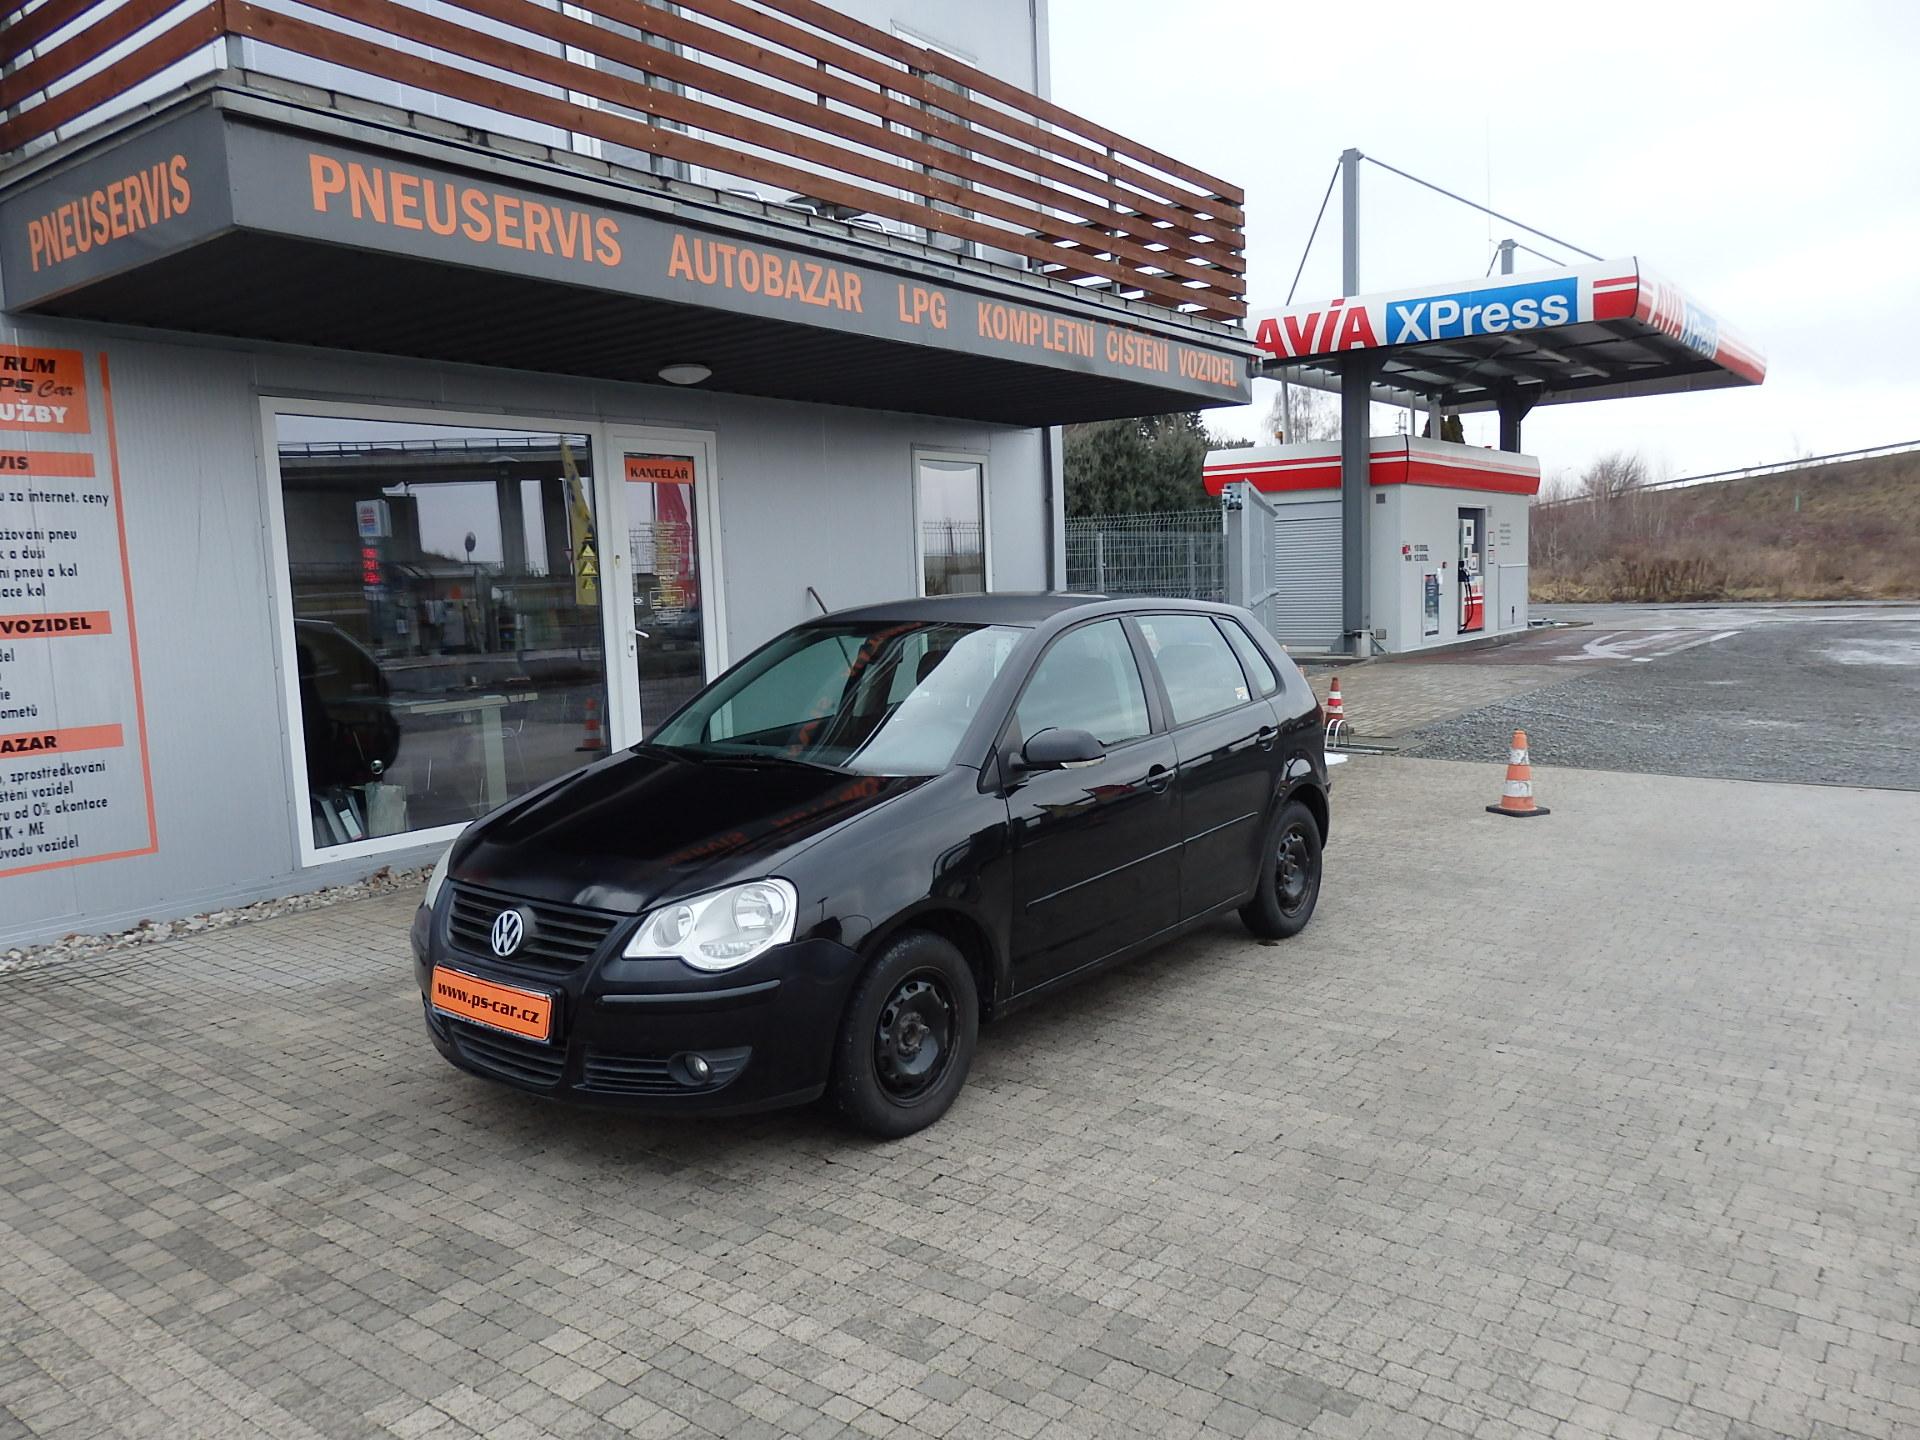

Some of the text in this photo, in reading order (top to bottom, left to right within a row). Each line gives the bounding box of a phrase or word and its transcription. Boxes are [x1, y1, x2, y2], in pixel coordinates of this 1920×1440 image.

[28, 153, 191, 272] PNEUSERVIS
[308, 153, 622, 267] PNEUSERVIS
[667, 234, 863, 313] AUTOBAZAR
[898, 283, 948, 329] LPG
[977, 301, 1096, 358] KOMPLETNÍ
[1178, 347, 1238, 387] VOZIDEL
[1395, 294, 1570, 345] XPress
[0, 355, 56, 374] RUM
[0, 399, 68, 424] UŽBY
[630, 466, 689, 479] KANCELÁŘ
[9, 492, 24, 502] za
[82, 493, 109, 507] ceny
[48, 531, 77, 543] pneu
[9, 550, 17, 559] a
[14, 568, 43, 581] pneu
[48, 568, 55, 577] a
[58, 563, 78, 577] kol
[27, 582, 46, 597] kol
[0, 617, 92, 634] VOZIDEL
[0, 735, 57, 753] AZAR
[32, 780, 74, 798] vozidel
[15, 804, 29, 819] od
[55, 798, 108, 814] akontace
[28, 821, 45, 837] ME
[37, 834, 79, 853] vozidel
[437, 982, 540, 1024] www.ps-car.cz
